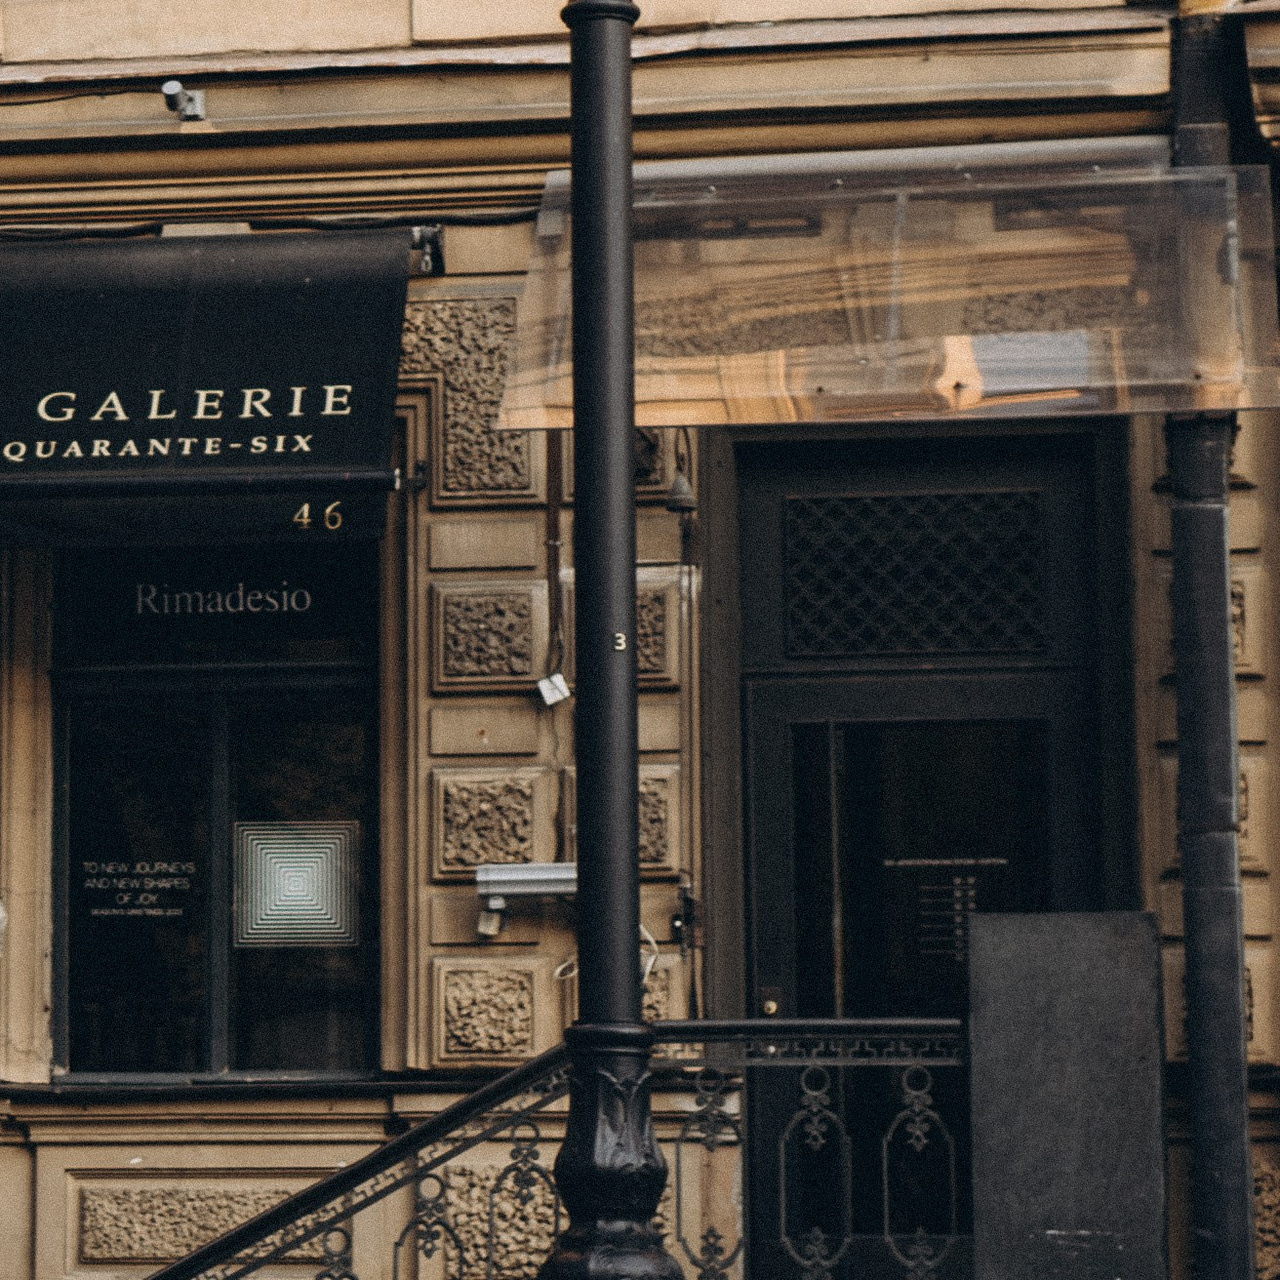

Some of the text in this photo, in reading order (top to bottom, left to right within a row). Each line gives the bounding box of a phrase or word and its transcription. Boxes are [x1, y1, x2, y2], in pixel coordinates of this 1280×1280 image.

[36, 384, 353, 423] GALERIE
[2, 434, 313, 462] QUARANTE-SIX
[293, 500, 344, 530] 46
[135, 581, 312, 615] Rimadesio
[614, 633, 627, 651] 3
[83, 861, 196, 874] TO NEW JOURNEYS
[84, 877, 191, 890] AND NEW SHAPES
[115, 892, 159, 905] OF JOY
